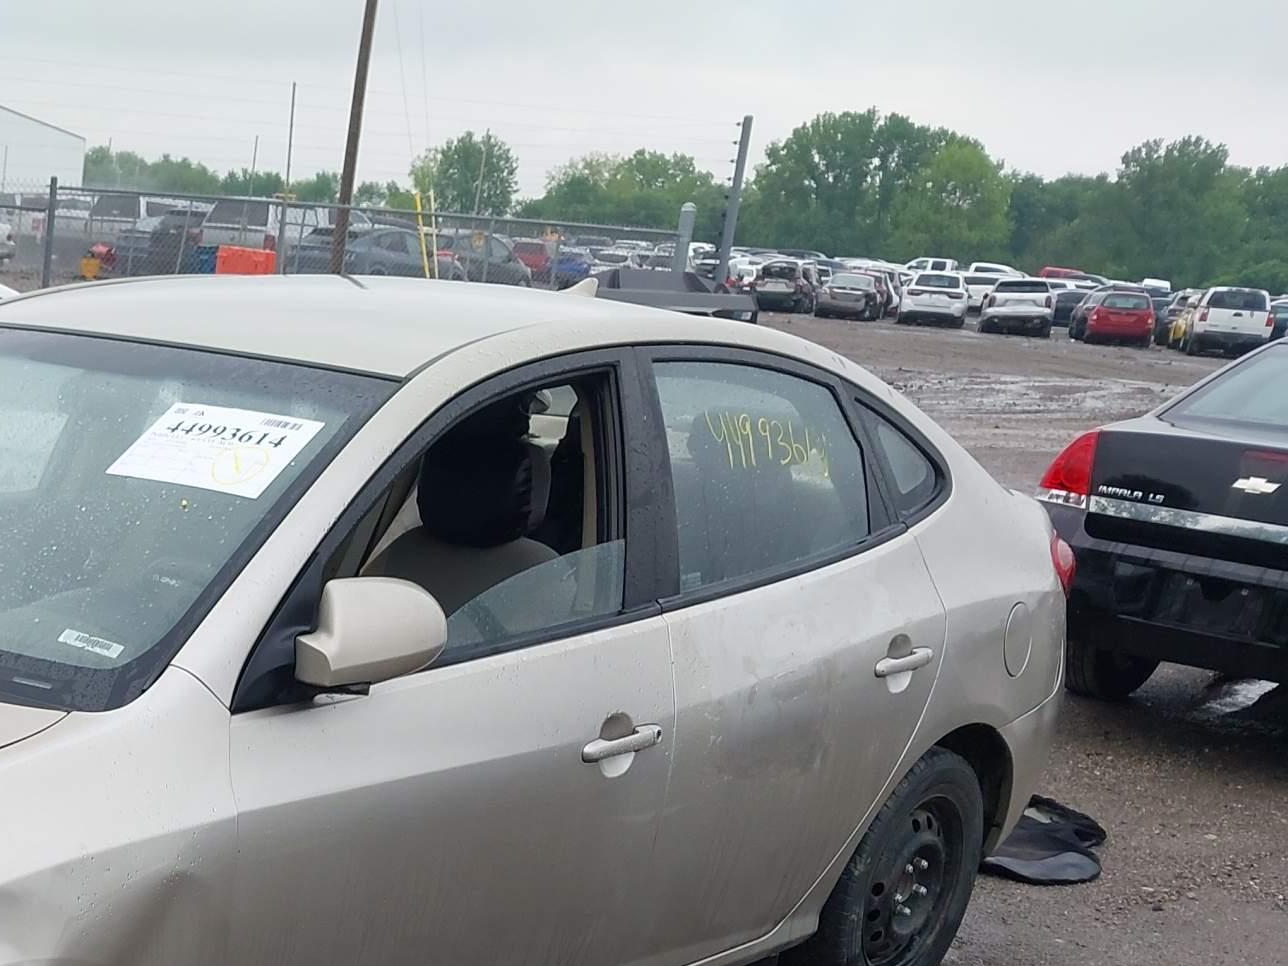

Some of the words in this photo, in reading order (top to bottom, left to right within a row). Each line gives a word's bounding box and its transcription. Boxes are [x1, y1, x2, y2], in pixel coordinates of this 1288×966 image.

[166, 421, 288, 448] 44993614
[1098, 485, 1143, 500] IMPALA
[1148, 493, 1165, 504] LS
